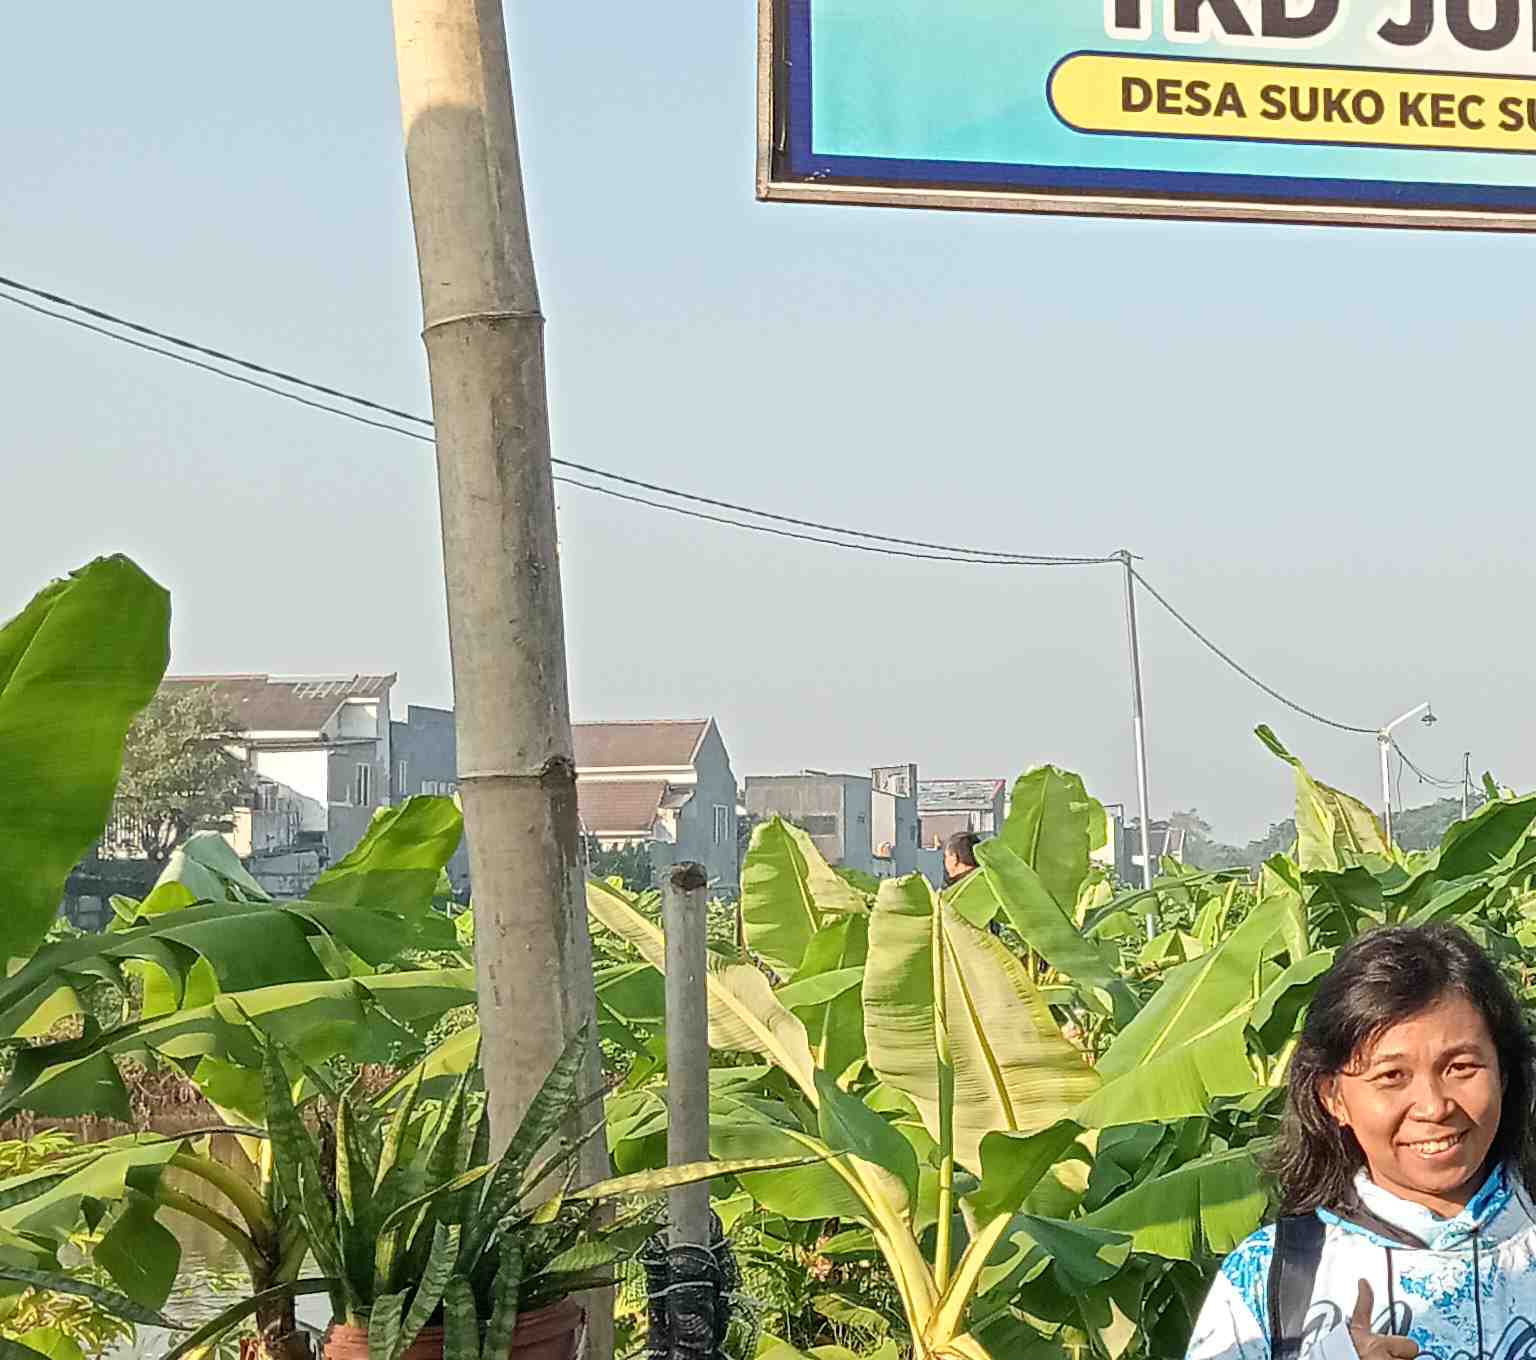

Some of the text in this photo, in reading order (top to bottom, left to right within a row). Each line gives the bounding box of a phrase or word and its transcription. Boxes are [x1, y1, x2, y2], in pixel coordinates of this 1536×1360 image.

[1120, 76, 1248, 119] DESA
[1258, 83, 1386, 124] SUKO
[1399, 91, 1486, 130] KEC
